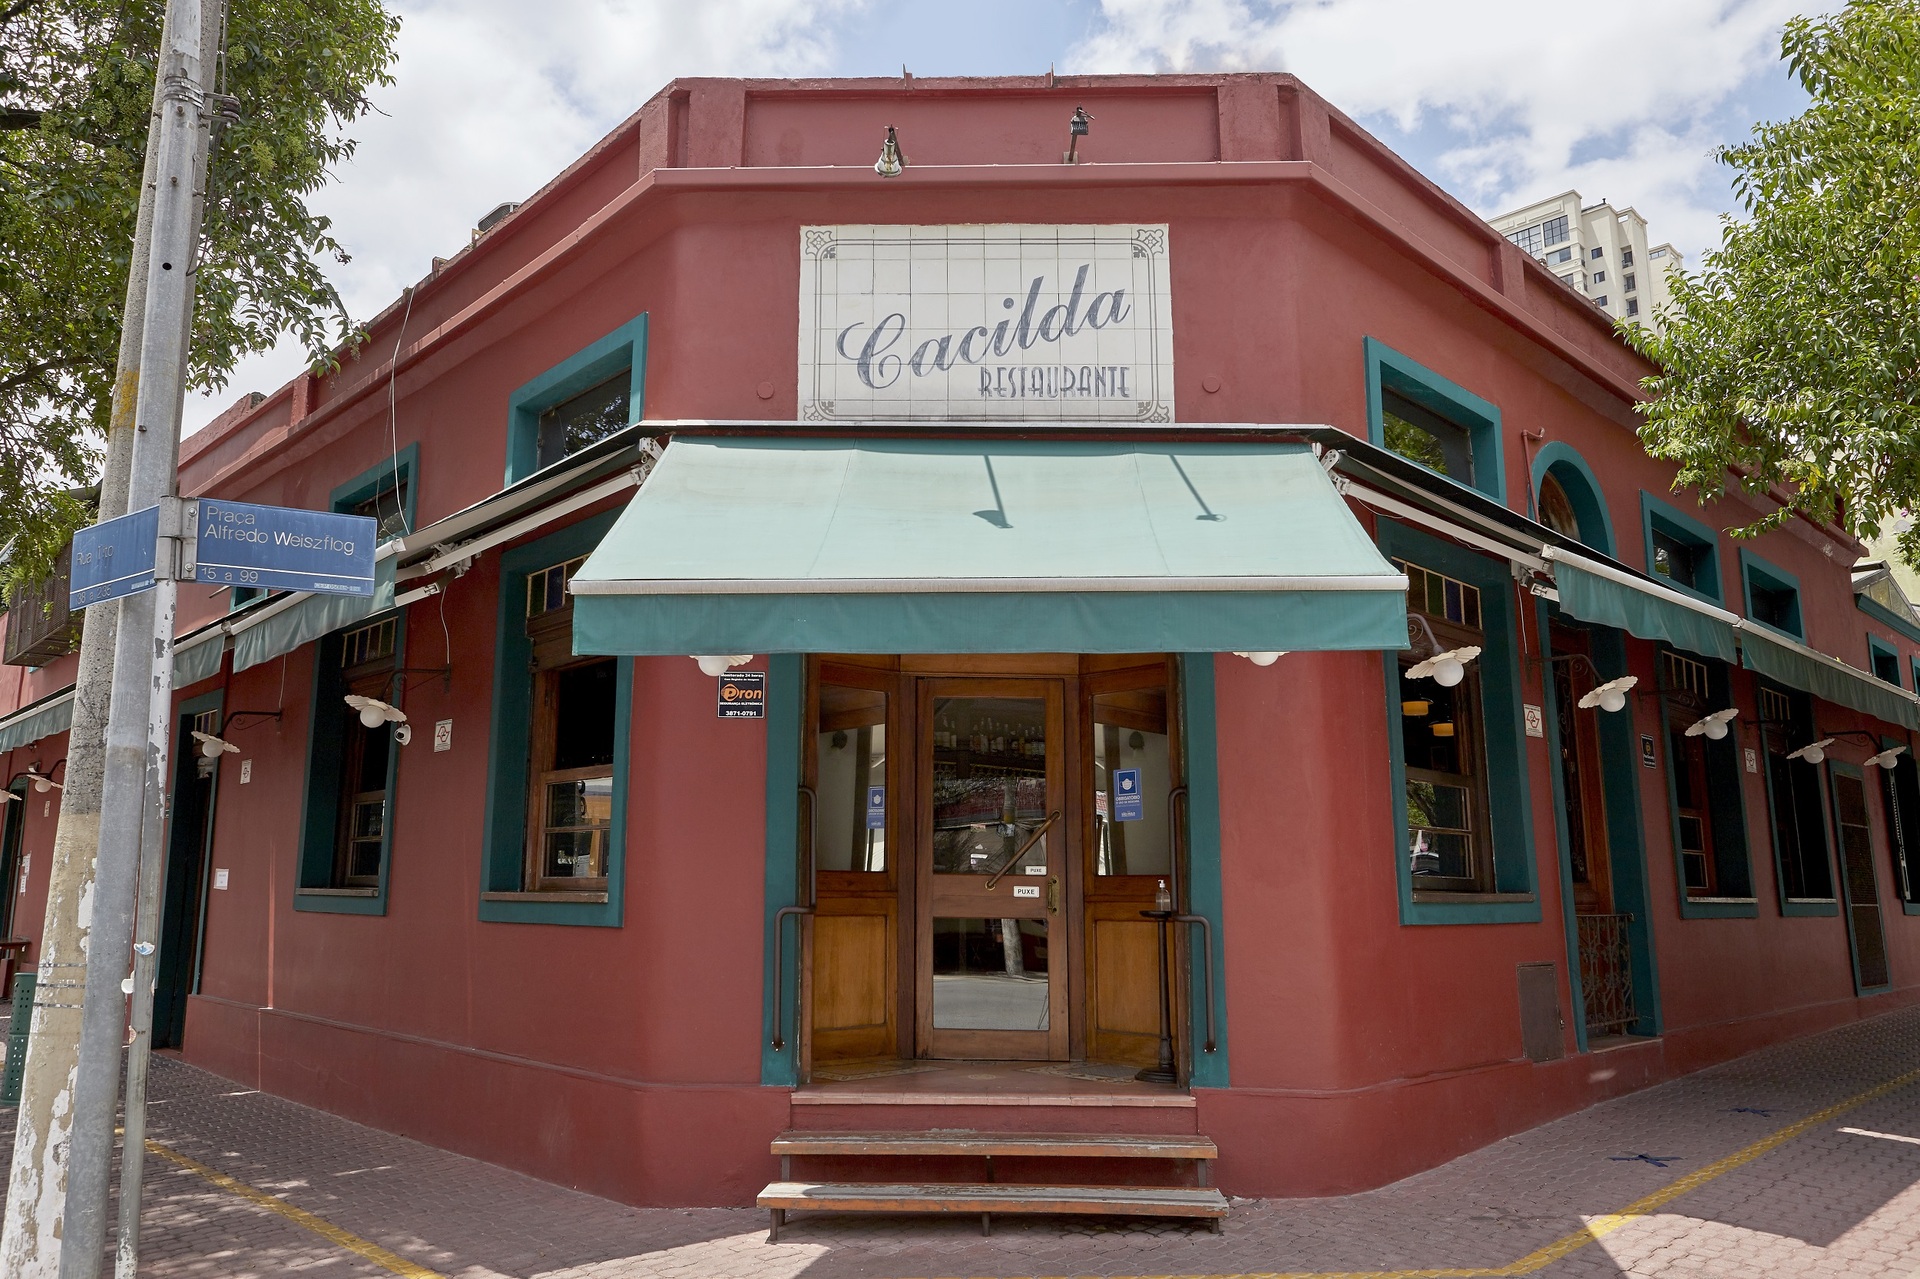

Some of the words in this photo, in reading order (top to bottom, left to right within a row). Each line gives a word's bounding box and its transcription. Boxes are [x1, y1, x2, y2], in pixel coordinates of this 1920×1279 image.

[836, 263, 1131, 389] Cacilda
[977, 365, 1130, 399] RESTAURANTE
[206, 506, 255, 527] Praça
[204, 523, 269, 544] Alfredo
[273, 530, 355, 556] Weiszflog
[76, 551, 92, 567] Rua
[201, 566, 217, 580] 15
[224, 571, 232, 582] a
[239, 570, 259, 584] 99
